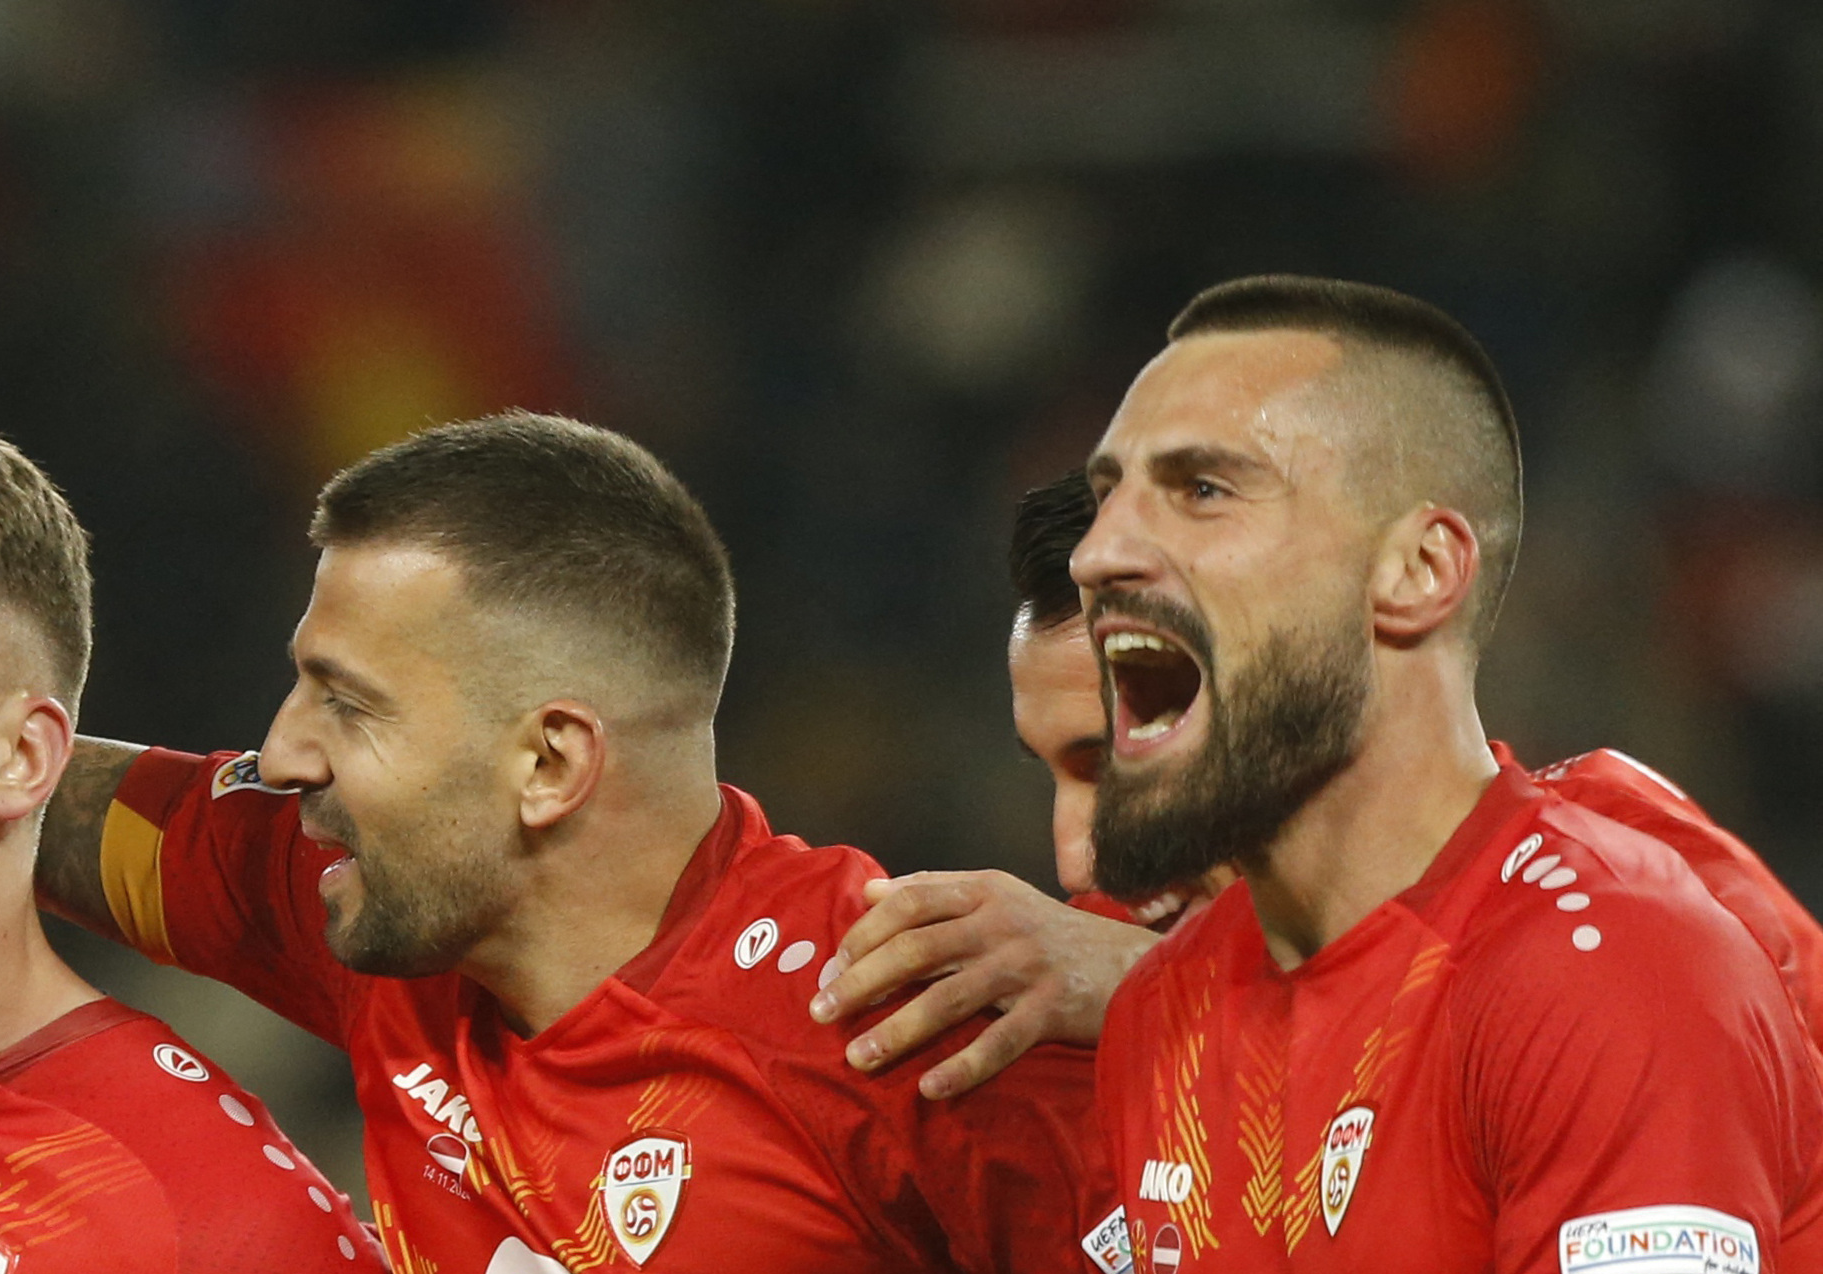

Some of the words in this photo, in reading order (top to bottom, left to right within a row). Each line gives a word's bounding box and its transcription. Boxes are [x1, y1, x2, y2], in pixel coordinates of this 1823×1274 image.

[613, 1147, 675, 1182] ФФМ
[1139, 1159, 1193, 1205] AKO
[1565, 1220, 1608, 1238] UEFA
[1565, 1229, 1755, 1265] FOUNDATION
